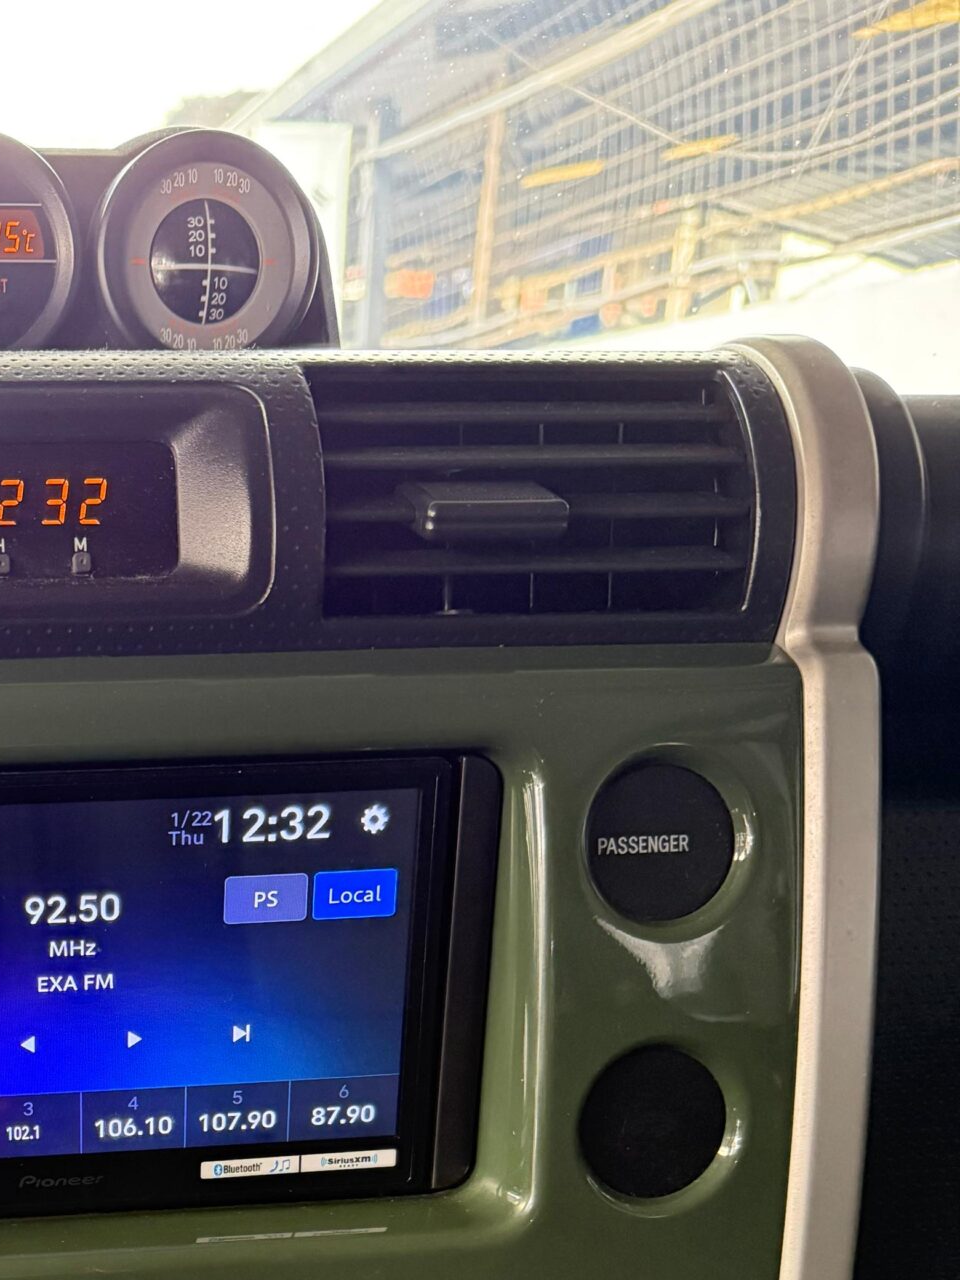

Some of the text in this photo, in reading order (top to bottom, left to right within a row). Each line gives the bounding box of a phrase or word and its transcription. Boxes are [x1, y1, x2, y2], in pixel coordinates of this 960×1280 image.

[187, 216, 205, 228] 30
[188, 230, 205, 242] 20
[188, 244, 206, 257] 10
[213, 277, 228, 290] 10
[211, 293, 227, 306] 20
[208, 308, 224, 320] 30
[73, 536, 88, 552] M
[171, 810, 213, 829] 1/22
[213, 805, 331, 844] 12:32
[168, 829, 205, 847] Thu
[597, 834, 690, 856] PASSENGER
[253, 890, 279, 908] PS
[328, 884, 382, 905] Local
[24, 893, 122, 925] 92.50
[48, 940, 97, 958] MHz
[37, 973, 115, 993] EXA FM
[232, 1090, 243, 1105] 5
[339, 1084, 349, 1099] 6
[23, 1102, 34, 1116] 3
[127, 1095, 139, 1110] 4
[198, 1109, 277, 1133] 107.90
[310, 1104, 376, 1127] 87.90
[6, 1124, 41, 1142] 102.1
[94, 1115, 174, 1139] 106.10
[223, 1163, 261, 1174] Bluetooth
[18, 1174, 105, 1189] Pioneer
